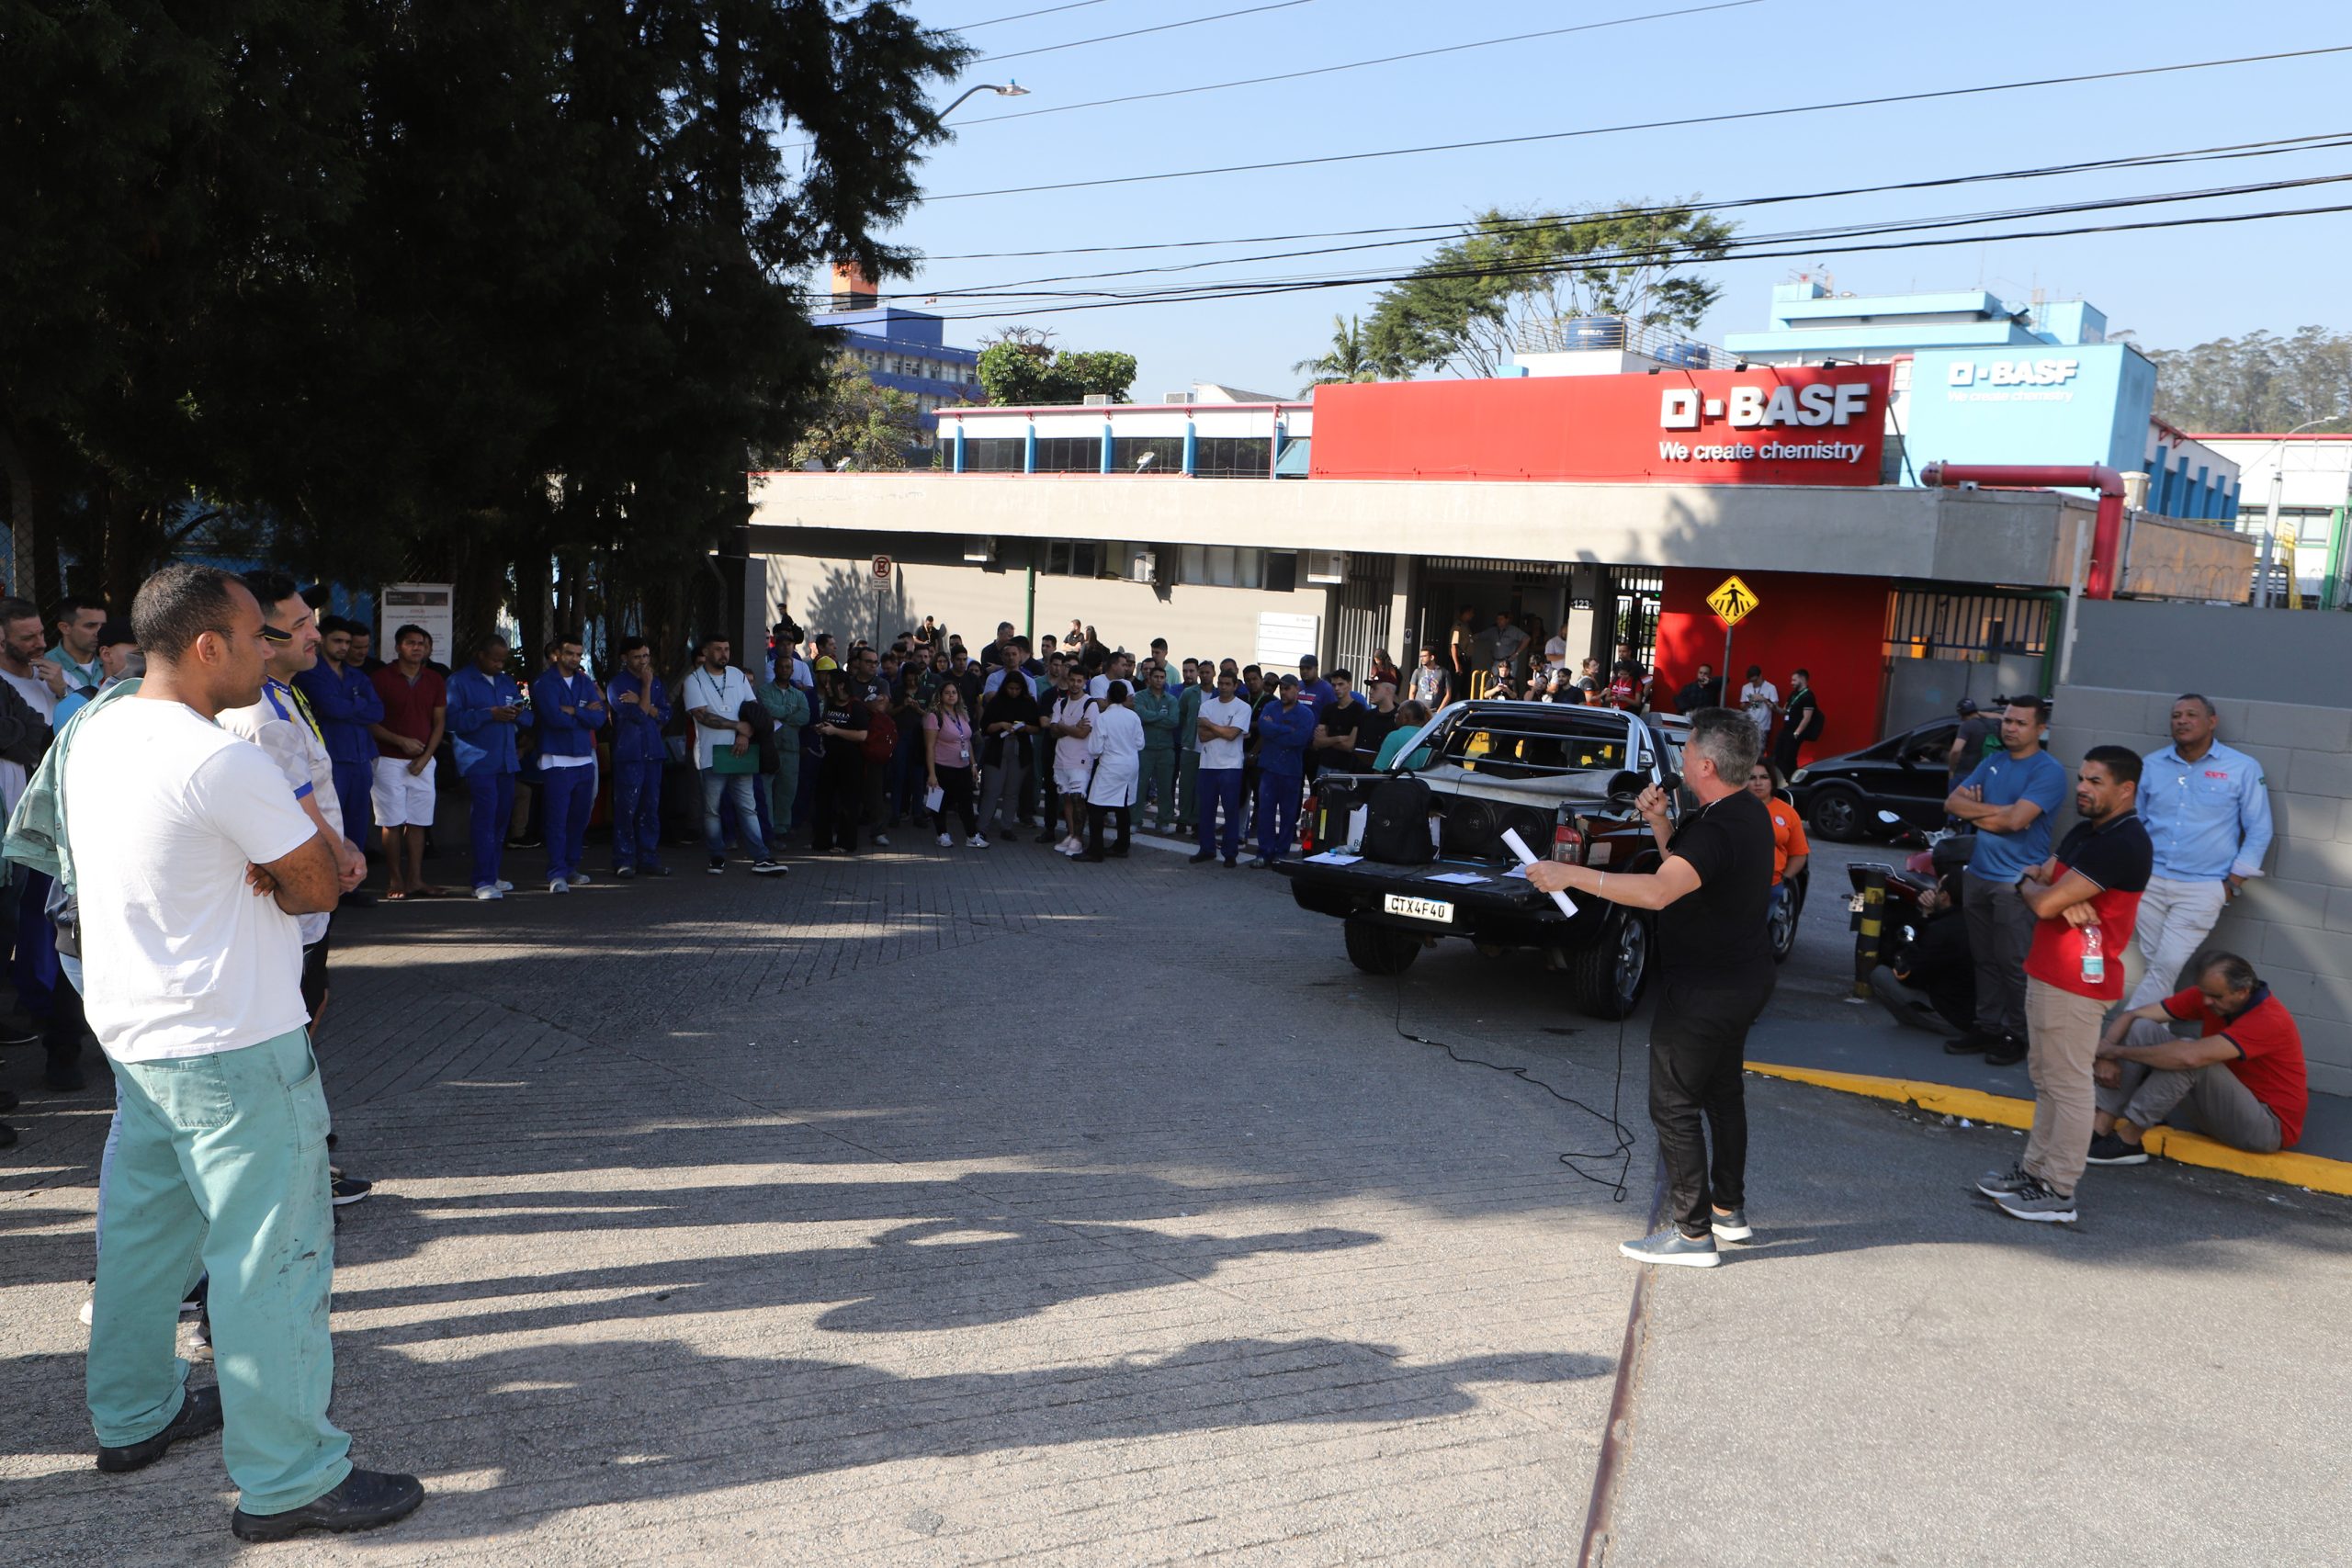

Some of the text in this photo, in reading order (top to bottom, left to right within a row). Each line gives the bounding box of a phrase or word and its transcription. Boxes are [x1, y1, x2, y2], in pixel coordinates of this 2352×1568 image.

[1990, 359, 2079, 386] BASF
[1728, 383, 1871, 426] BASF
[1947, 389, 2074, 402] We create chemistry
[1659, 441, 1864, 463] We create chemistry
[1574, 600, 1589, 609] 123
[1391, 897, 1445, 918] CTX4F40
